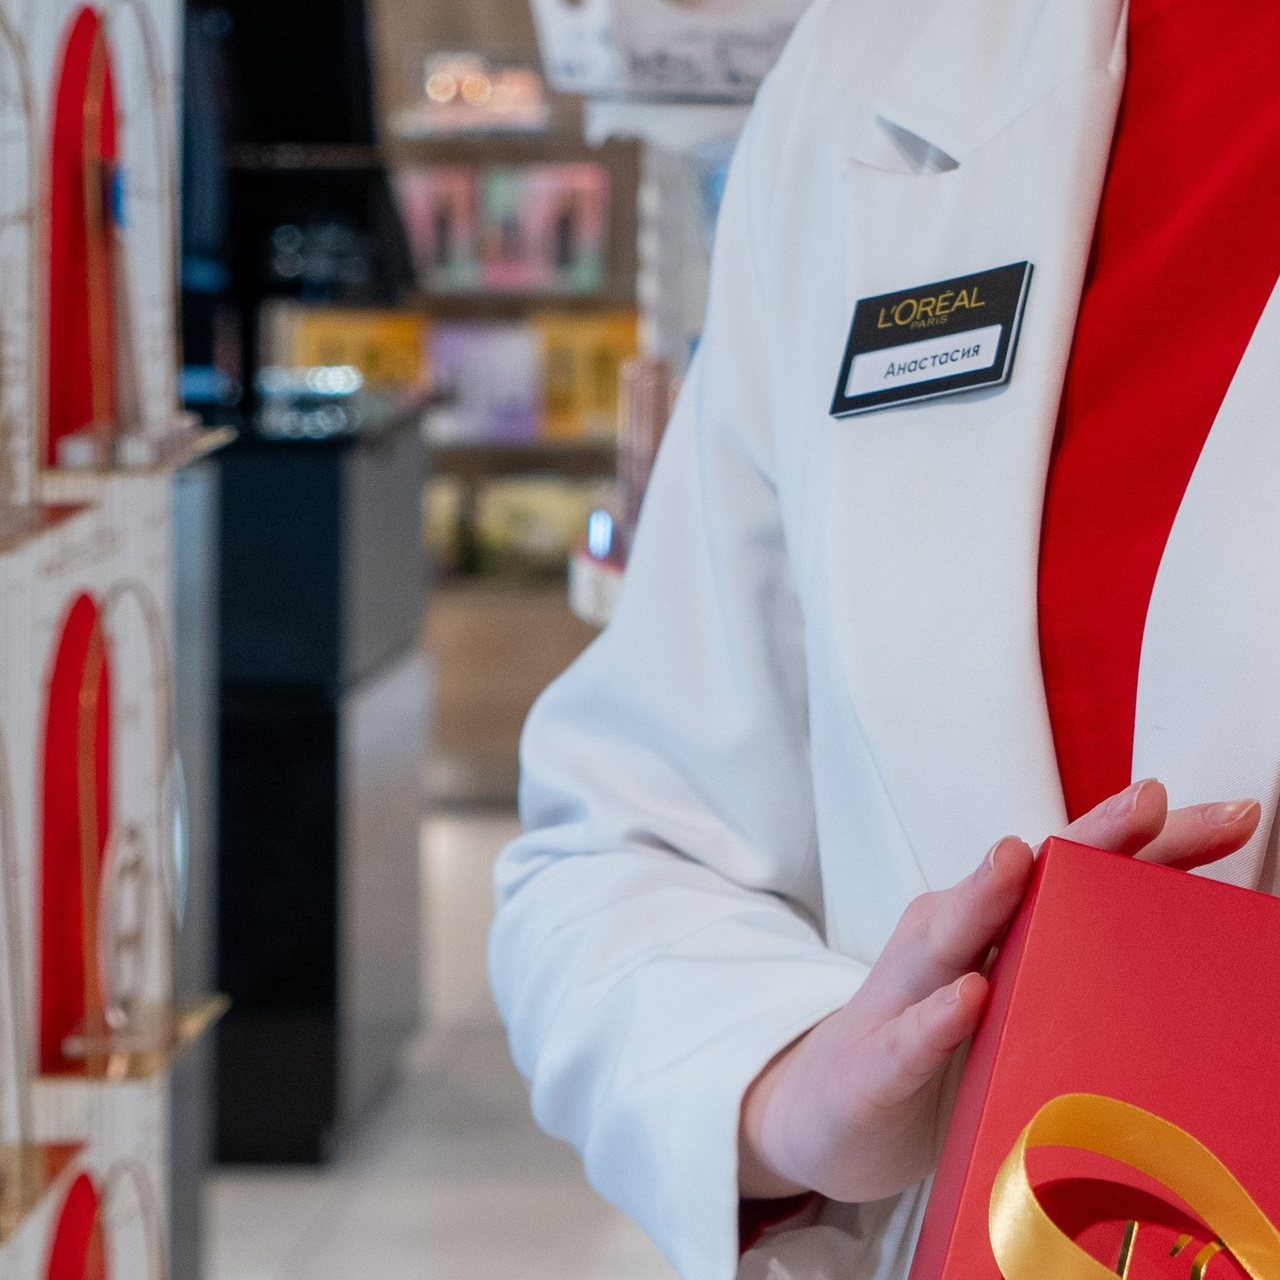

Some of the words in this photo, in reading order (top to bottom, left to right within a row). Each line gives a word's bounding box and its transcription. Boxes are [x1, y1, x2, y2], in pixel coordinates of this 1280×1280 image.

[877, 286, 986, 329] L'ORÉAL
[910, 314, 949, 331] PARIS
[883, 344, 981, 380] Анастасия
